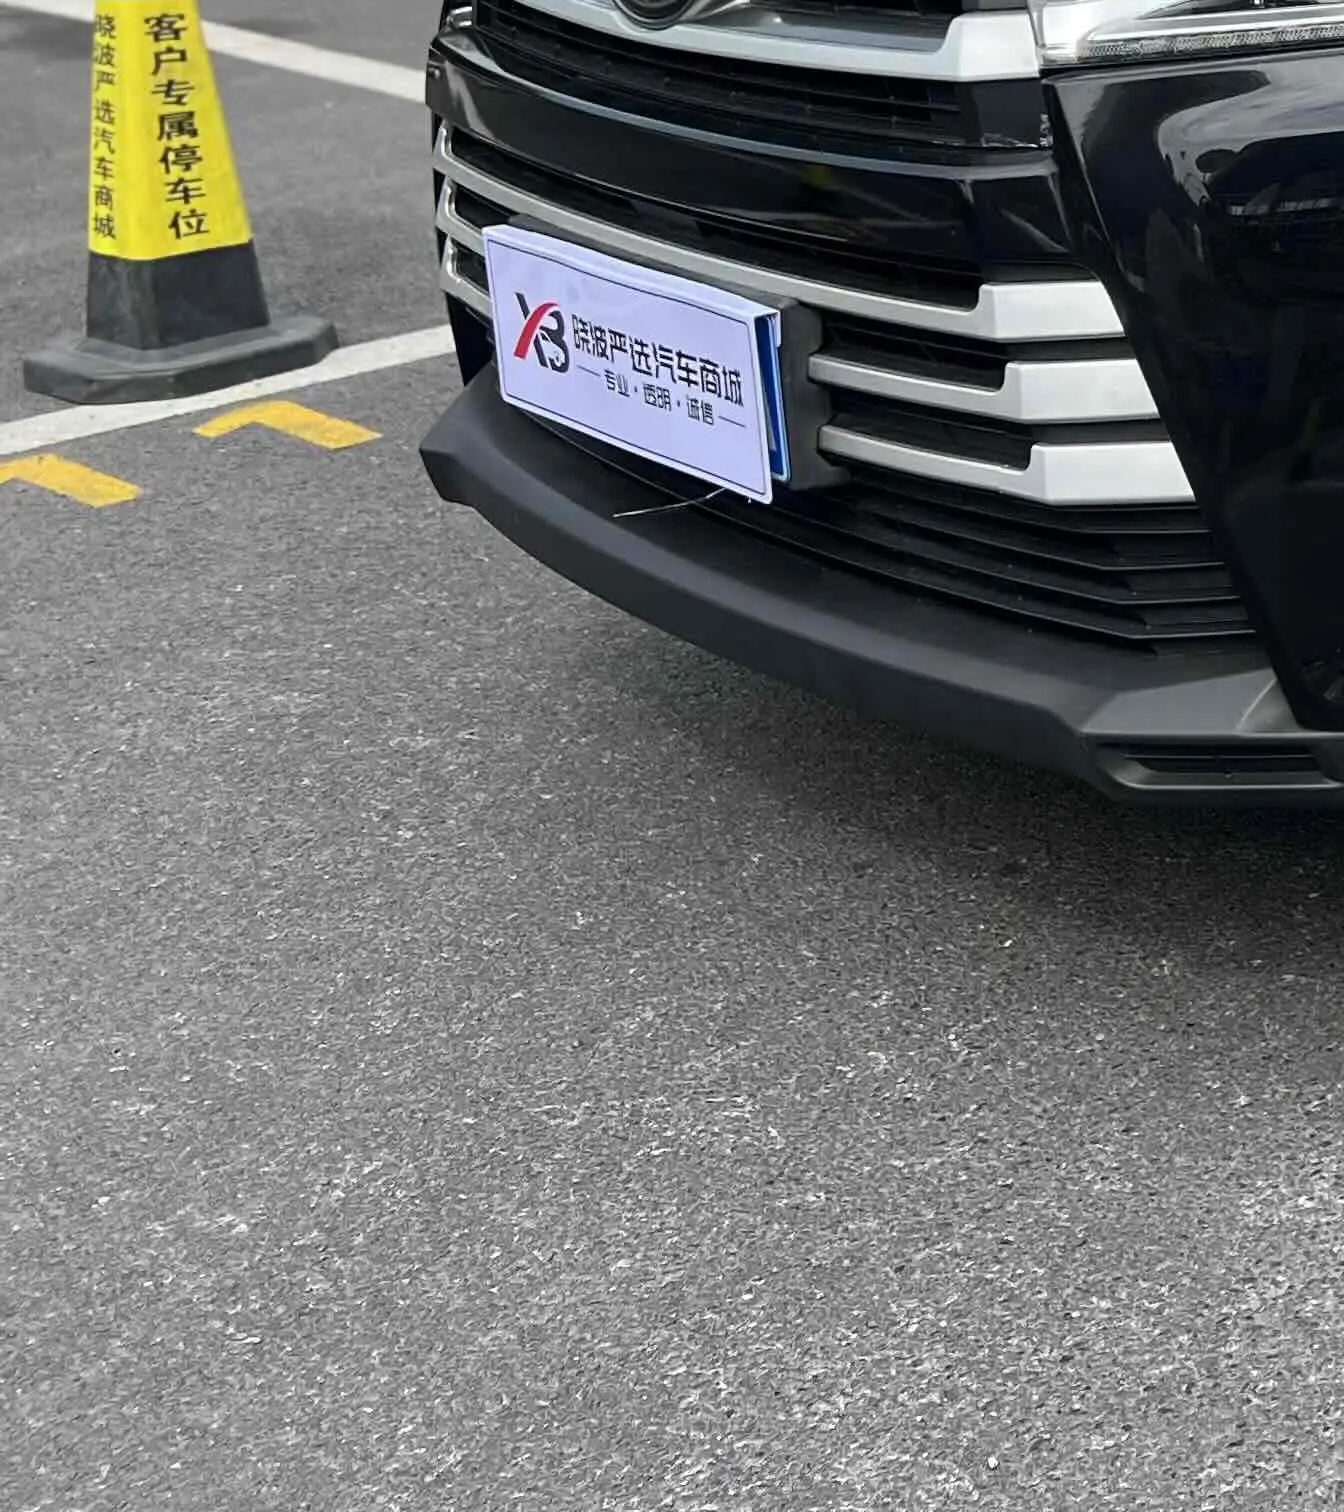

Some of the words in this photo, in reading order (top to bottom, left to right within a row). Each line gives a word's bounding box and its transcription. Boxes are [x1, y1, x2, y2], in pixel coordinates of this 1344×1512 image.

[144, 13, 209, 239] 客户专属停车位
[571, 314, 744, 407] 晓波严选汽车商城
